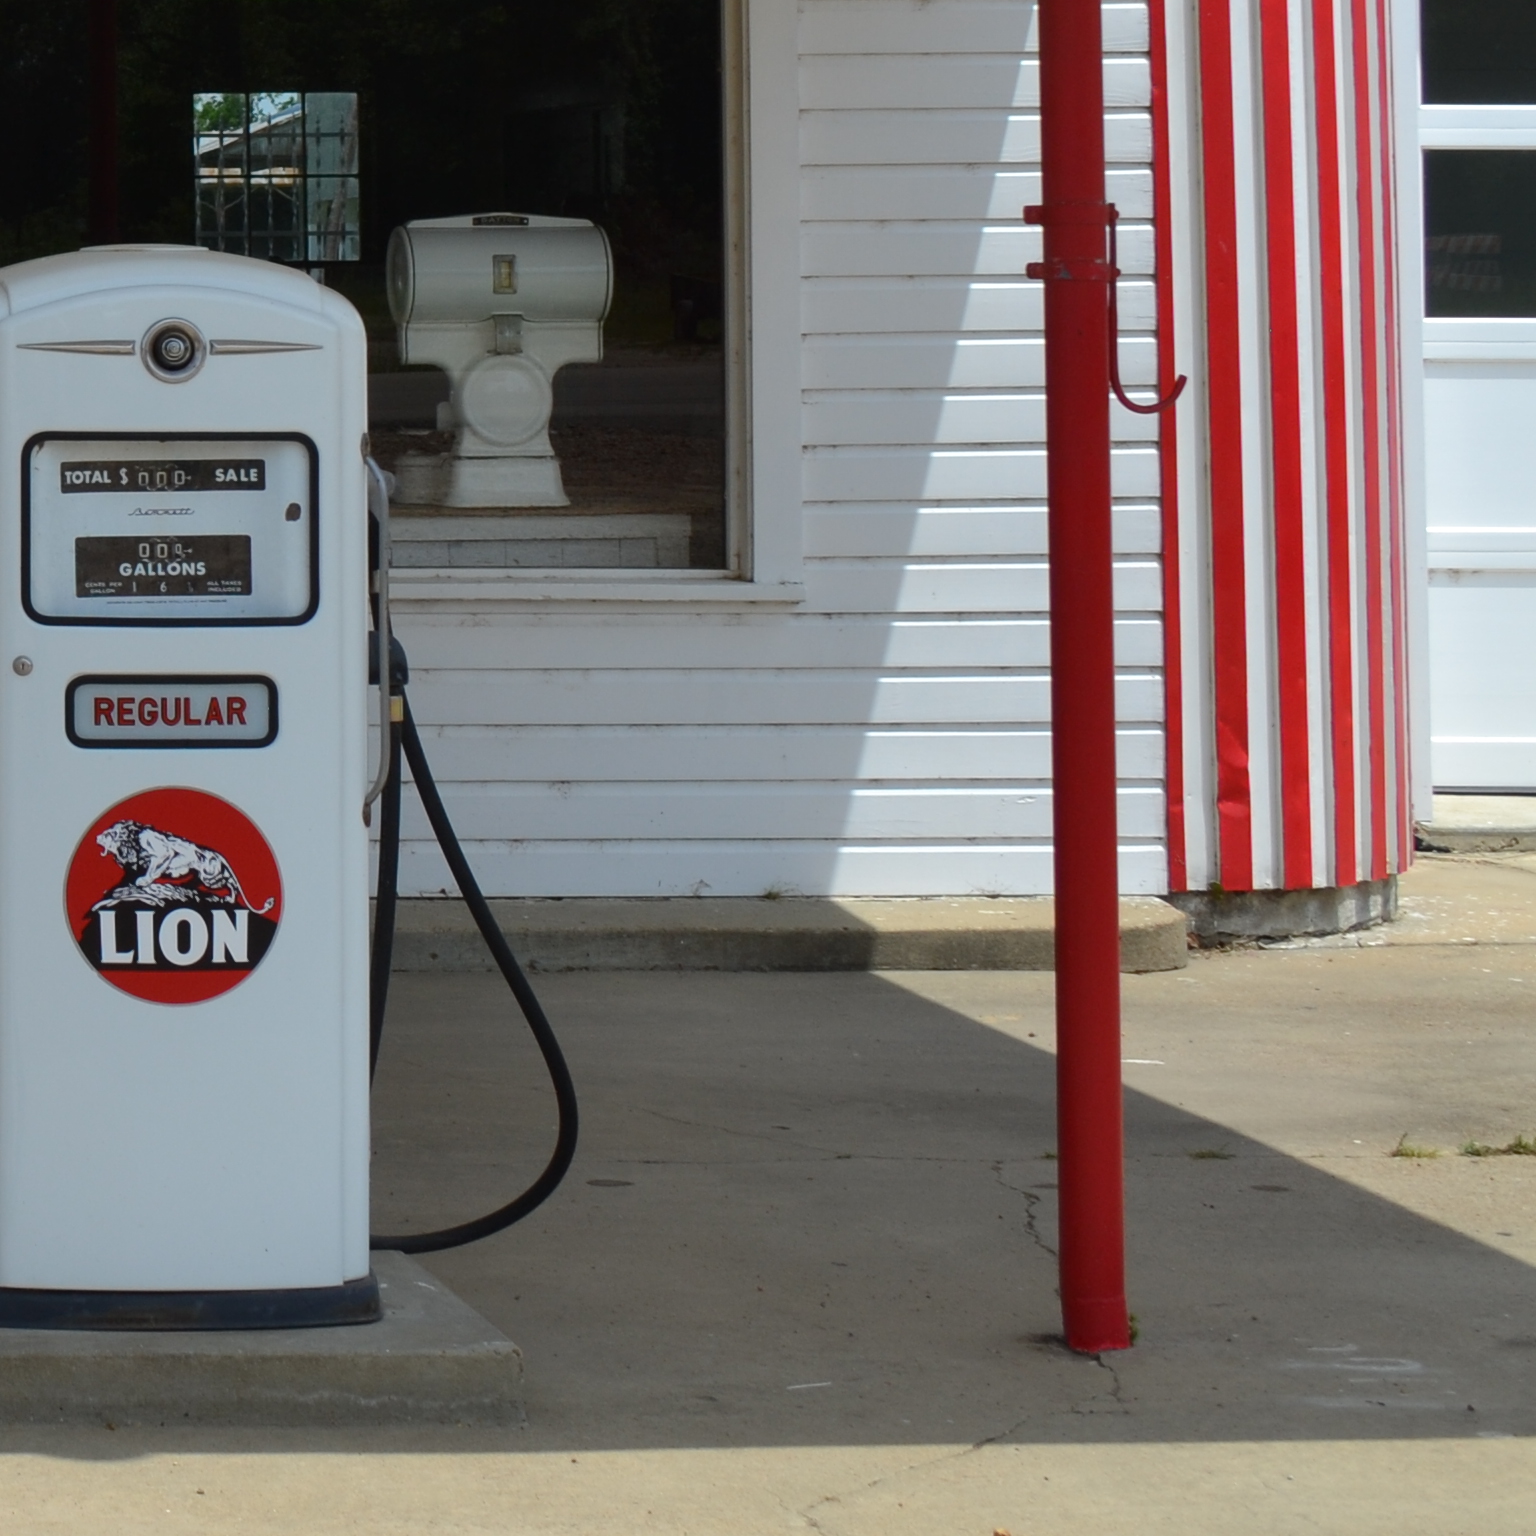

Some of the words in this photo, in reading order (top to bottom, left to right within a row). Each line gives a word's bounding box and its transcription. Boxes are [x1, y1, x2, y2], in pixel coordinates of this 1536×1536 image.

[64, 470, 112, 485] TOTAL
[119, 467, 129, 486] $
[215, 468, 259, 482] SALE
[118, 561, 207, 577] GALLONS
[93, 696, 248, 727] REGULAR
[97, 907, 250, 966] LION
